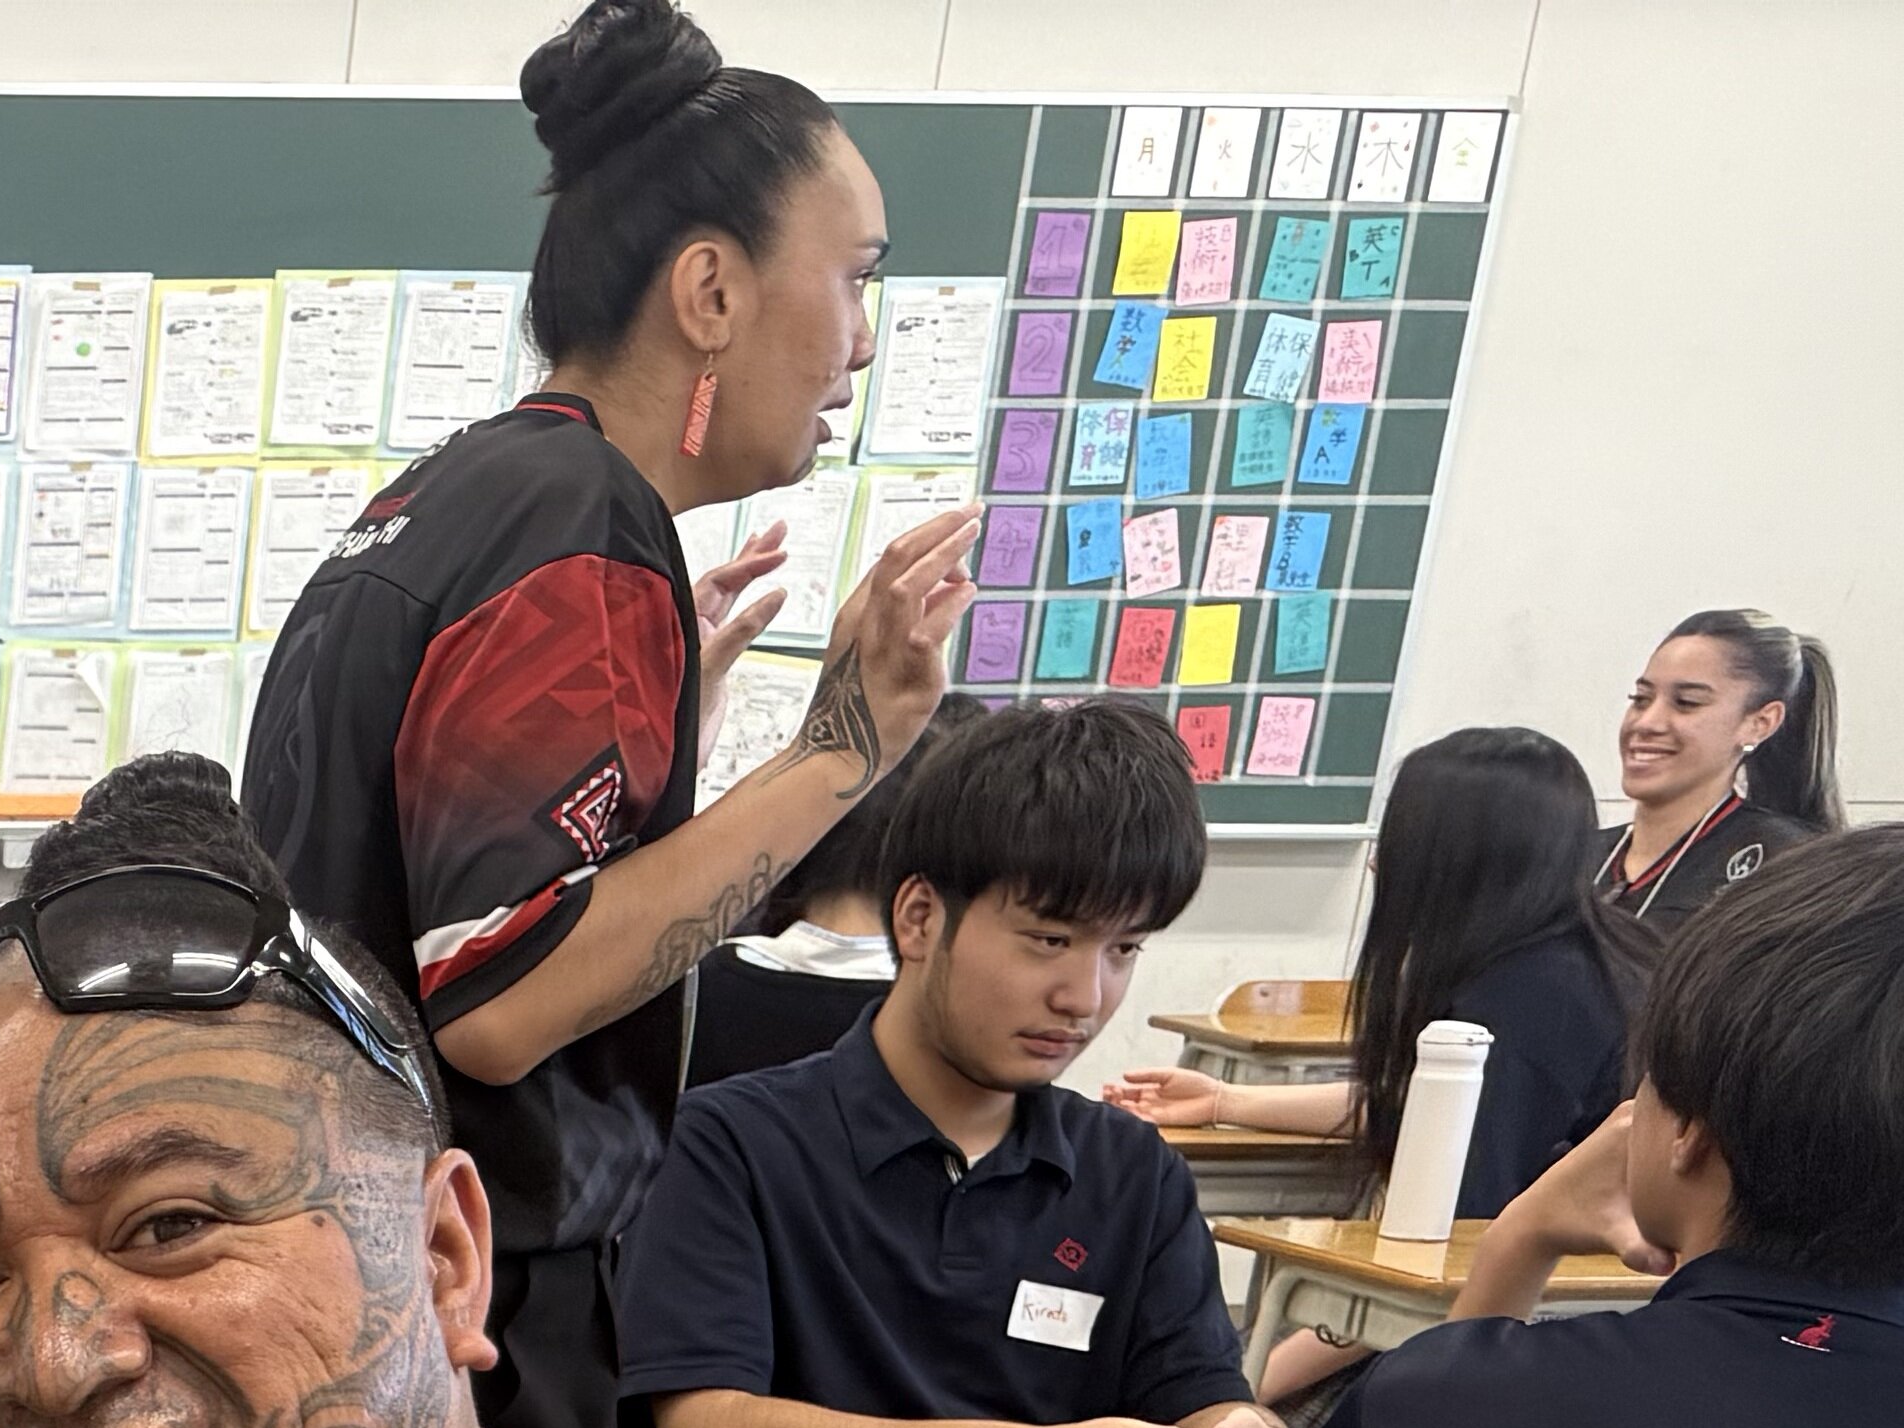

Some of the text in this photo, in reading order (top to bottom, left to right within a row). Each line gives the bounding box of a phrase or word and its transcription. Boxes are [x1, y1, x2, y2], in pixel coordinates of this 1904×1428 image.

[1137, 136, 1156, 165] 月
[1218, 138, 1233, 161] 火
[1286, 131, 1324, 175] 水
[1365, 137, 1405, 178] 木
[1031, 224, 1077, 280] 1
[1017, 322, 1058, 383] 2
[1003, 419, 1042, 482] 3
[989, 520, 1031, 569] 4
[974, 611, 1018, 674] 5
